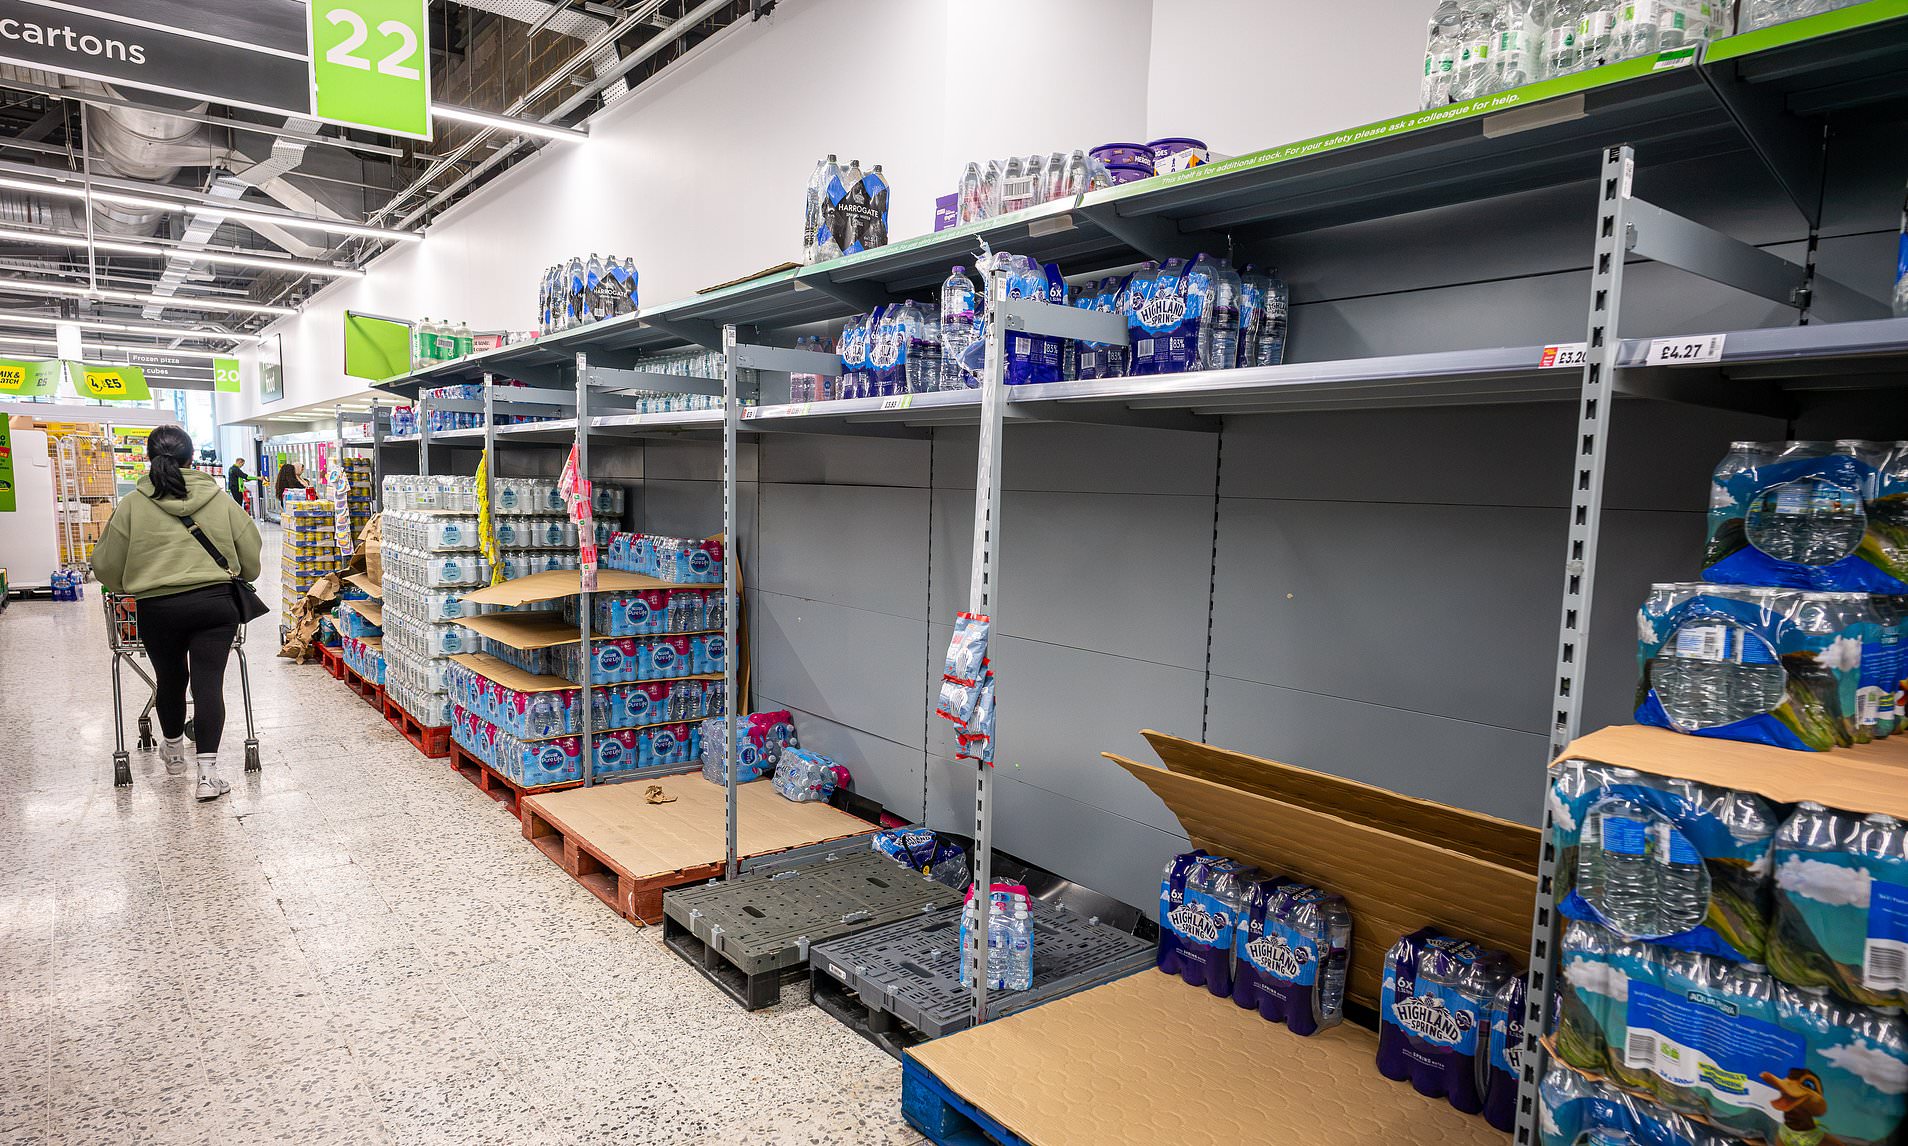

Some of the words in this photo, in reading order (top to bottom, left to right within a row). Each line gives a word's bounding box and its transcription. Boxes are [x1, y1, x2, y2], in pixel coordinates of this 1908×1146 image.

[0, 18, 146, 65] cartons
[325, 8, 420, 81] 22
[1162, 177, 1176, 185] This
[1177, 172, 1196, 183] shelf
[1203, 167, 1215, 177] for
[1216, 157, 1258, 173] additional
[1258, 151, 1282, 162] stock.
[1284, 148, 1299, 157] For
[1301, 142, 1324, 154] your
[1324, 134, 1353, 147] safety
[1354, 126, 1386, 142] please
[1388, 120, 1406, 132] ask
[1407, 119, 1415, 127] a
[1417, 106, 1470, 124] colleague
[1472, 100, 1490, 111] for
[1492, 93, 1520, 107] help.
[838, 203, 879, 218] HARROGATE
[593, 288, 627, 298] HARROGATE
[1140, 300, 1184, 322] HIGHLAND
[1151, 314, 1176, 326] SPRING
[1172, 338, 1184, 350] 83%
[1660, 344, 1703, 360] £4.27
[106, 378, 122, 388] £5
[217, 370, 240, 382] 20
[1171, 888, 1182, 900] 6x
[1171, 912, 1216, 940] HIGHLAND
[1182, 923, 1205, 939] SPRING
[1250, 920, 1264, 931] 6x
[1250, 944, 1297, 976] HIGHLAND
[1260, 957, 1285, 974] SPRING
[1397, 976, 1413, 990] 6x
[1396, 1006, 1459, 1041] HIGHLAND
[1410, 1020, 1443, 1040] SPRING
